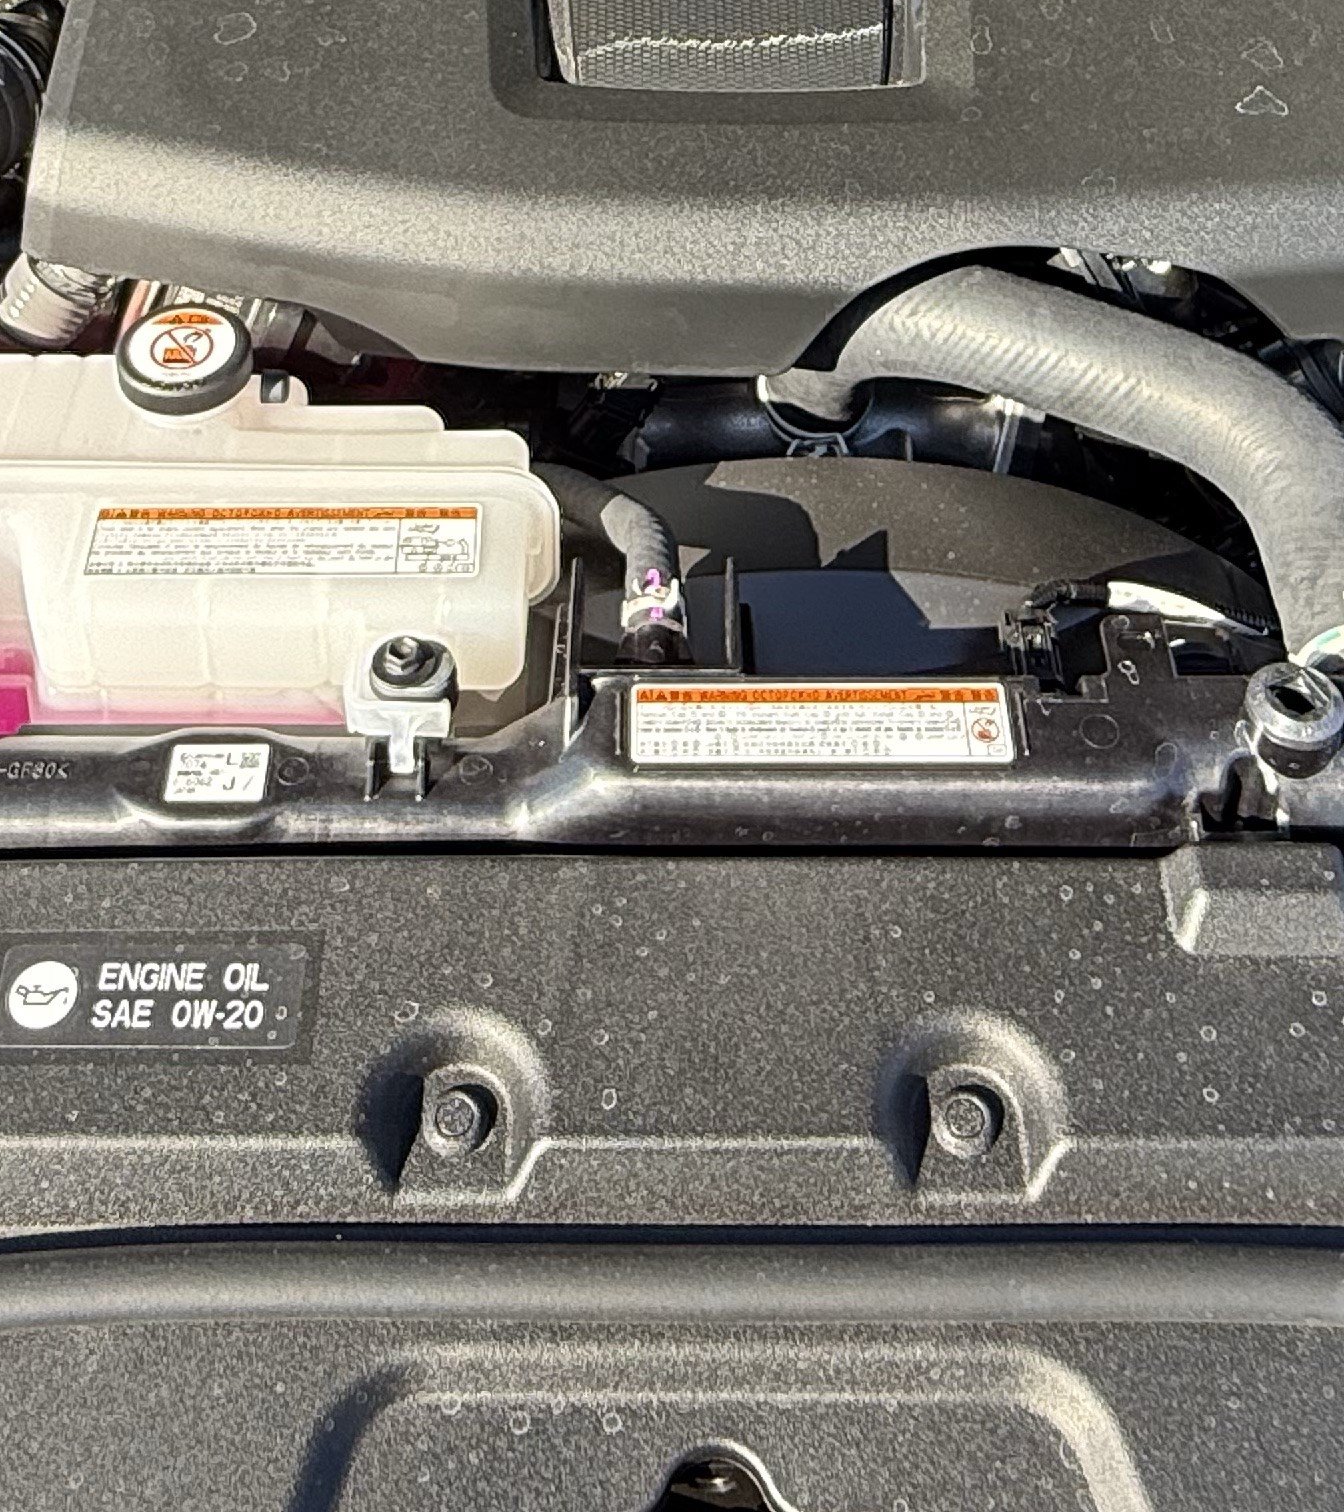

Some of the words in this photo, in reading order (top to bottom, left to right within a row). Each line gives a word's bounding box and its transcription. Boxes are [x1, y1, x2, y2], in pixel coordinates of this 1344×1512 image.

[97, 962, 208, 992] ENGINE
[222, 962, 270, 992] OIL
[90, 999, 155, 1029] SAE
[171, 999, 265, 1030] 0W-20
